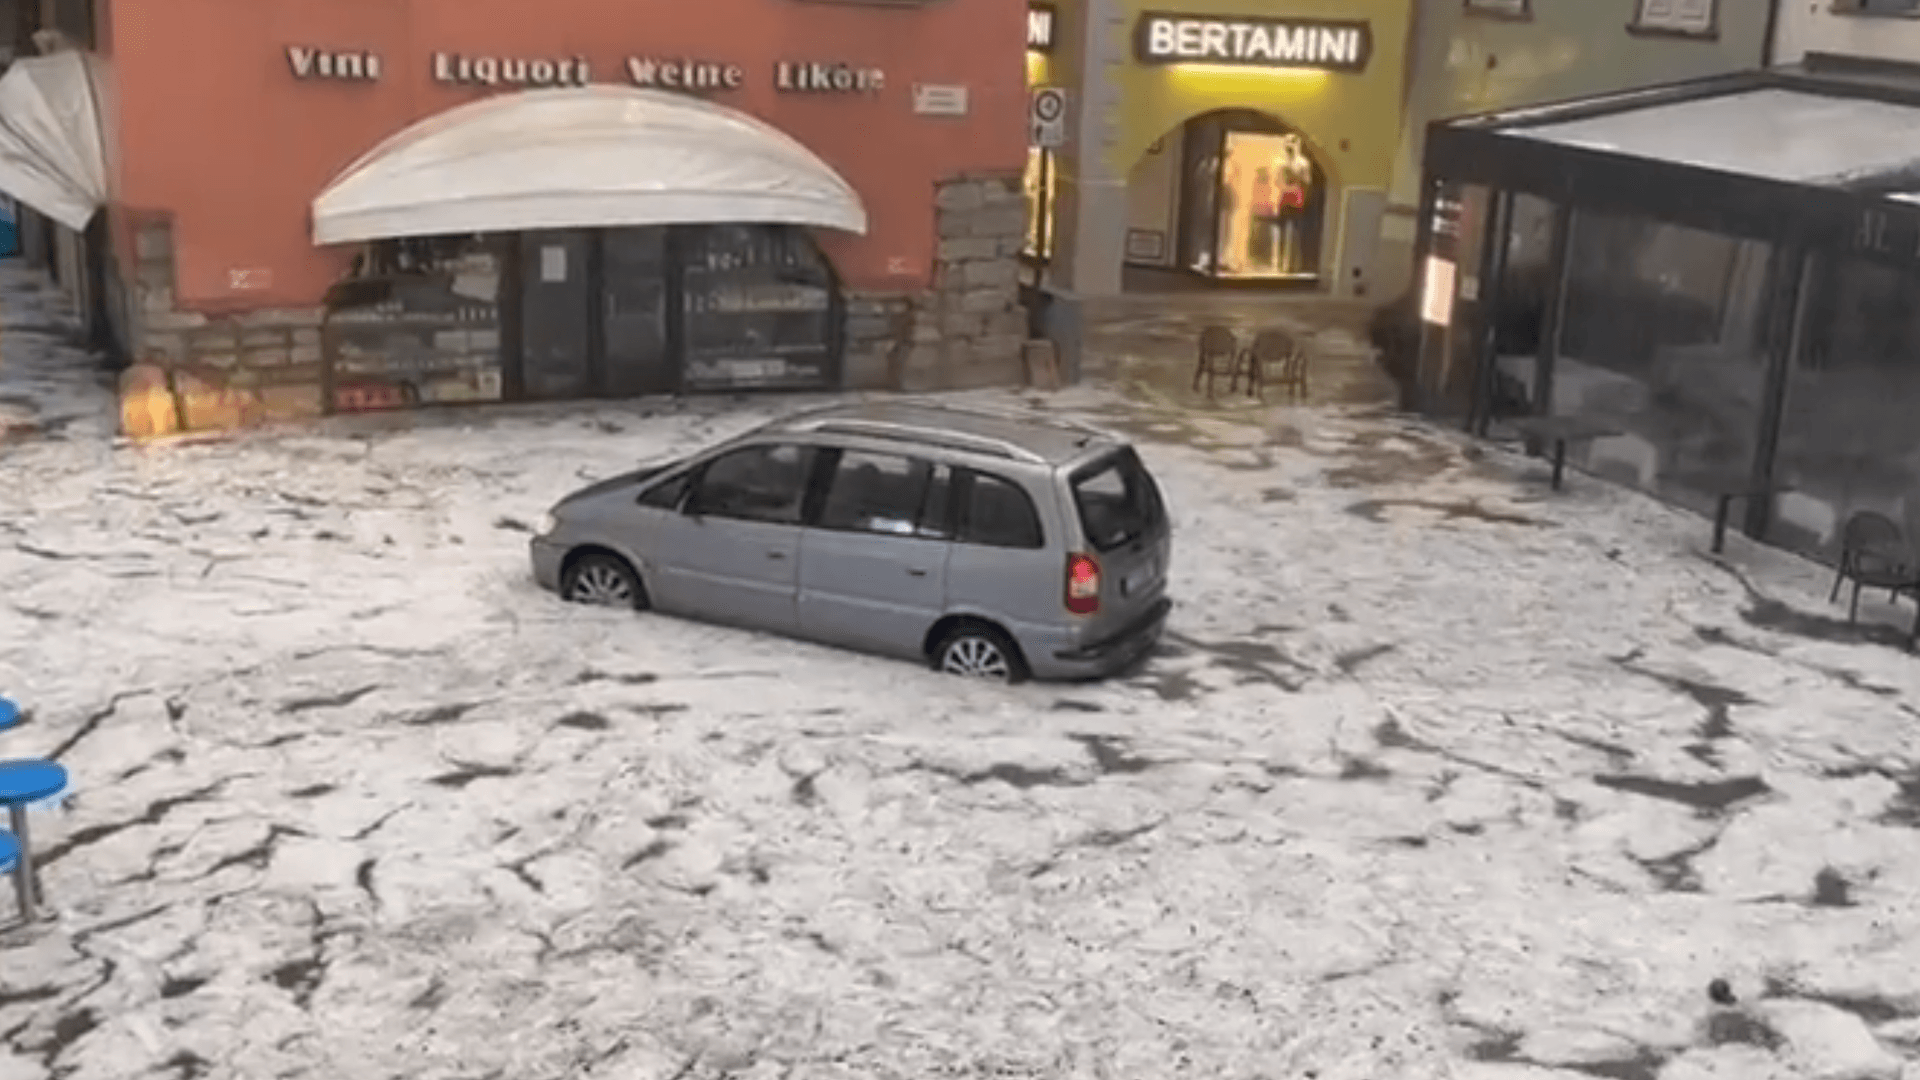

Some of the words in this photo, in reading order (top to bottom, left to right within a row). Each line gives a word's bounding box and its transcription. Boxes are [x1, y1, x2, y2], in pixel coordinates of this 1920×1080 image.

[1150, 18, 1360, 62] BERTAMINI
[434, 52, 590, 85] Liquori
[627, 56, 743, 90] Weine
